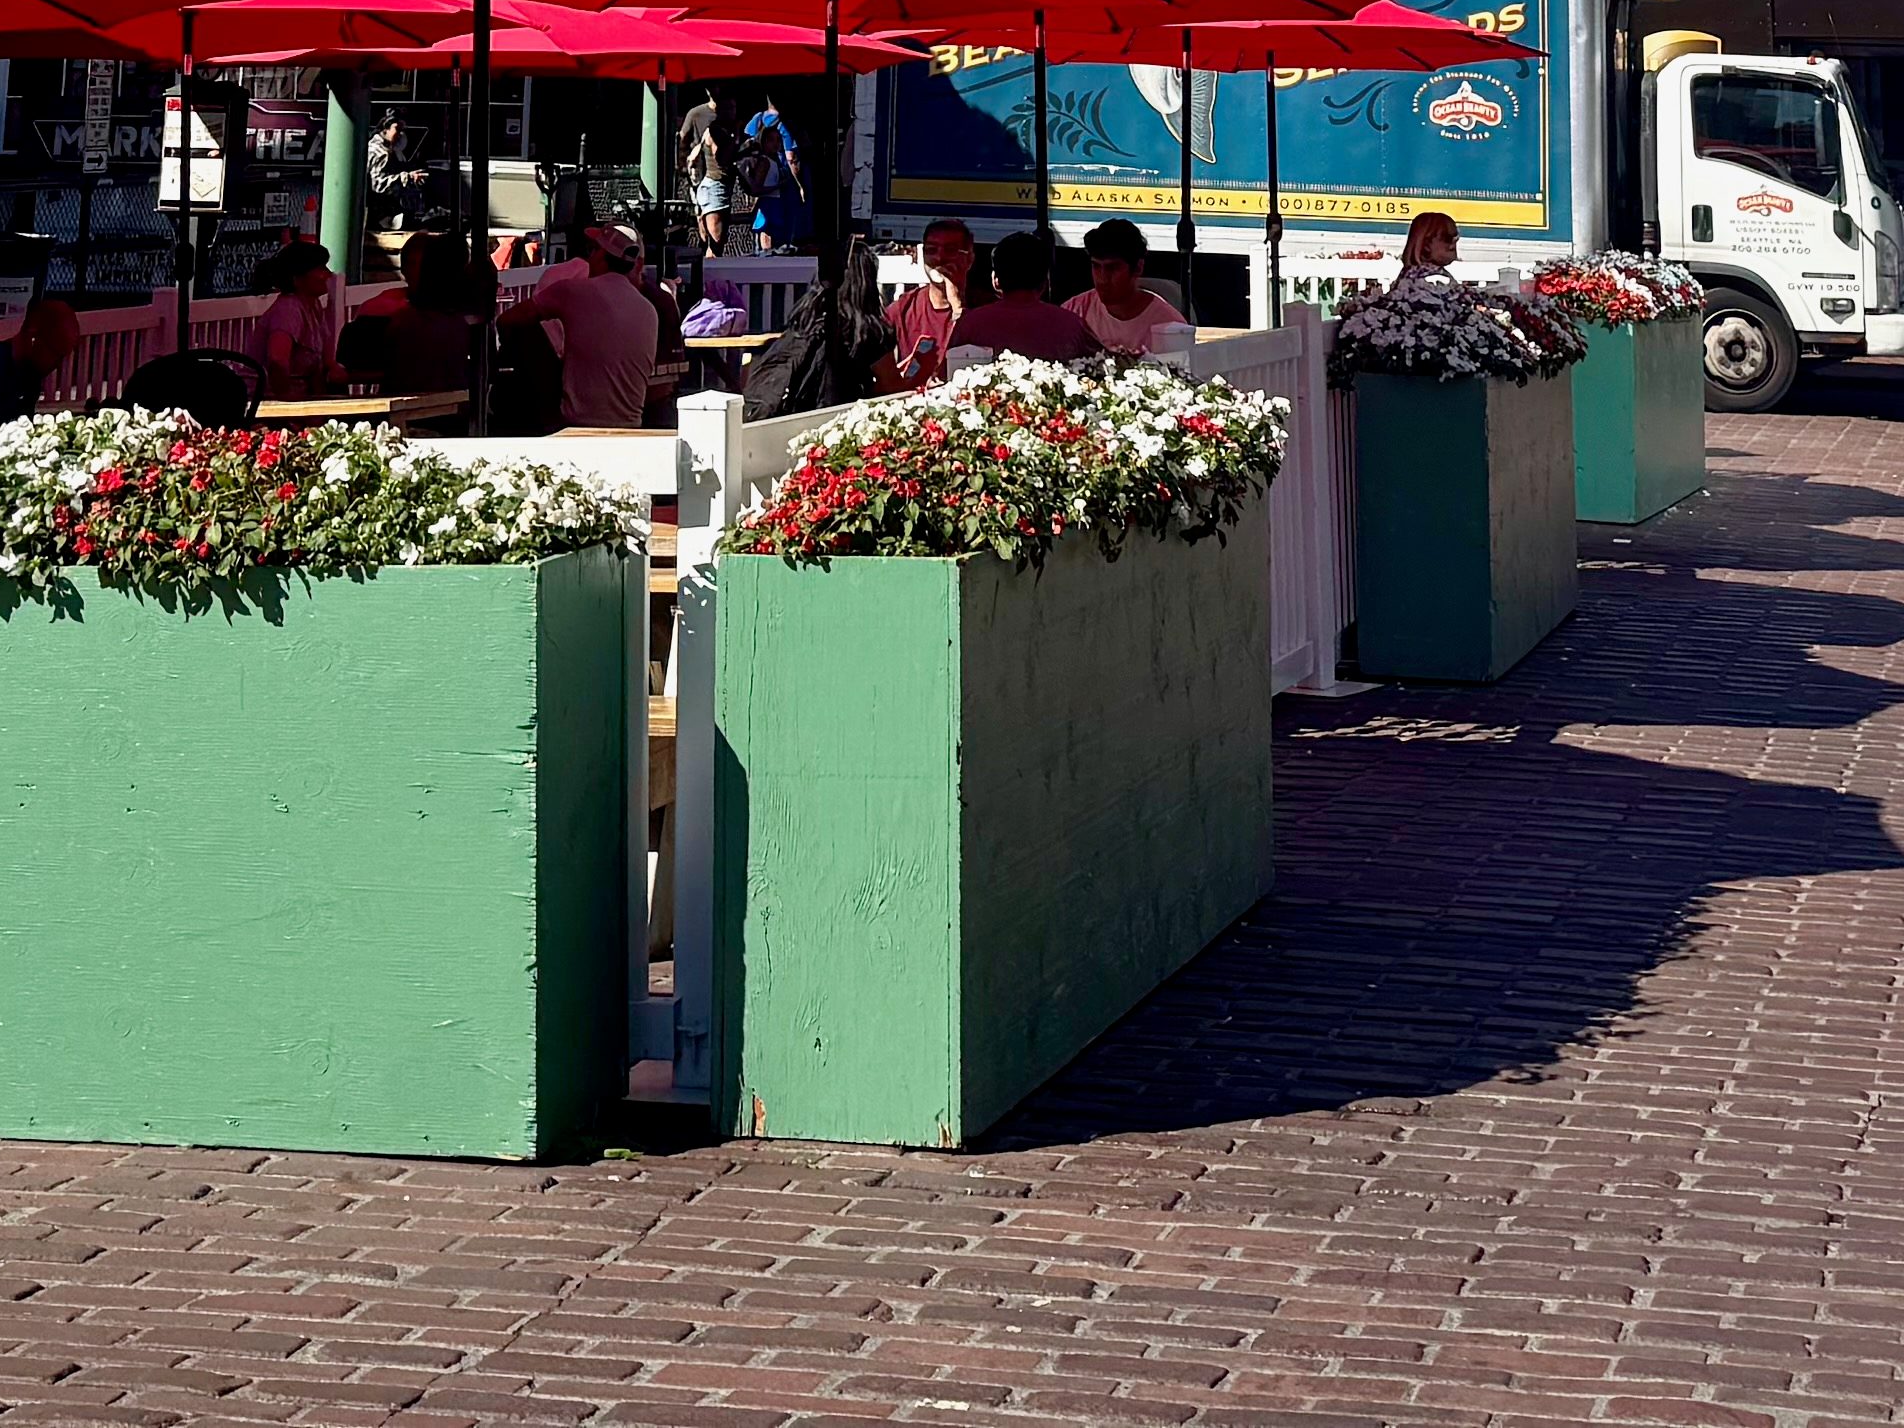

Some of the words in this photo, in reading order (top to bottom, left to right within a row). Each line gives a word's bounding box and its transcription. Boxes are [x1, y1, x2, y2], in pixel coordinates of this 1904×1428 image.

[1433, 102, 1462, 118] OCEAN
[1463, 101, 1497, 120] BEAUTY
[1015, 186, 1061, 202] WD
[1071, 189, 1144, 205] ALASKA
[1153, 192, 1229, 209] SAMON
[1258, 197, 1411, 215] (00)877-0185
[1787, 282, 1814, 291] GVW
